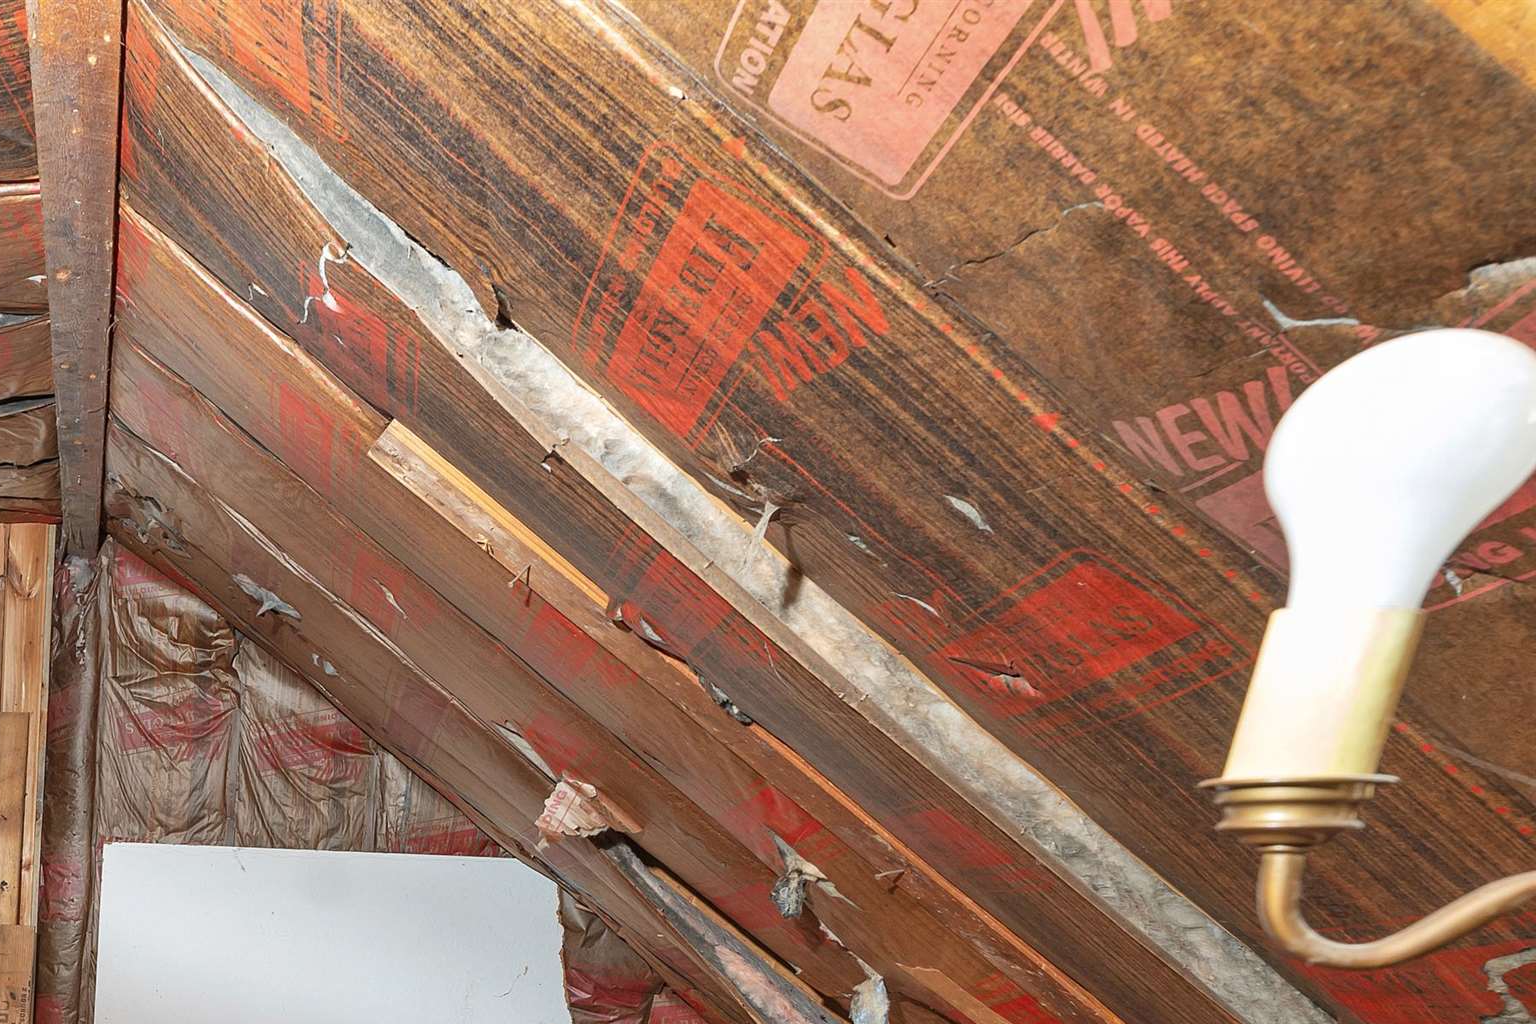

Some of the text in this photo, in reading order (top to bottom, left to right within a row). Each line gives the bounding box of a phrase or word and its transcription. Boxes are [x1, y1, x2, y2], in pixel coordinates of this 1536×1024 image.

[905, 0, 993, 108] ORNING
[1039, 31, 1109, 98] WINTER
[1109, 98, 1137, 122] IN
[1029, 125, 1097, 186] BARRIER
[1135, 124, 1207, 183] HEATED
[1094, 183, 1153, 239] VAPOR
[1200, 182, 1260, 233] SPACE
[1149, 236, 1192, 274] THIS
[1255, 235, 1321, 294] LIVING
[1183, 274, 1239, 316] APPLY
[1237, 319, 1322, 384] PORTANT
